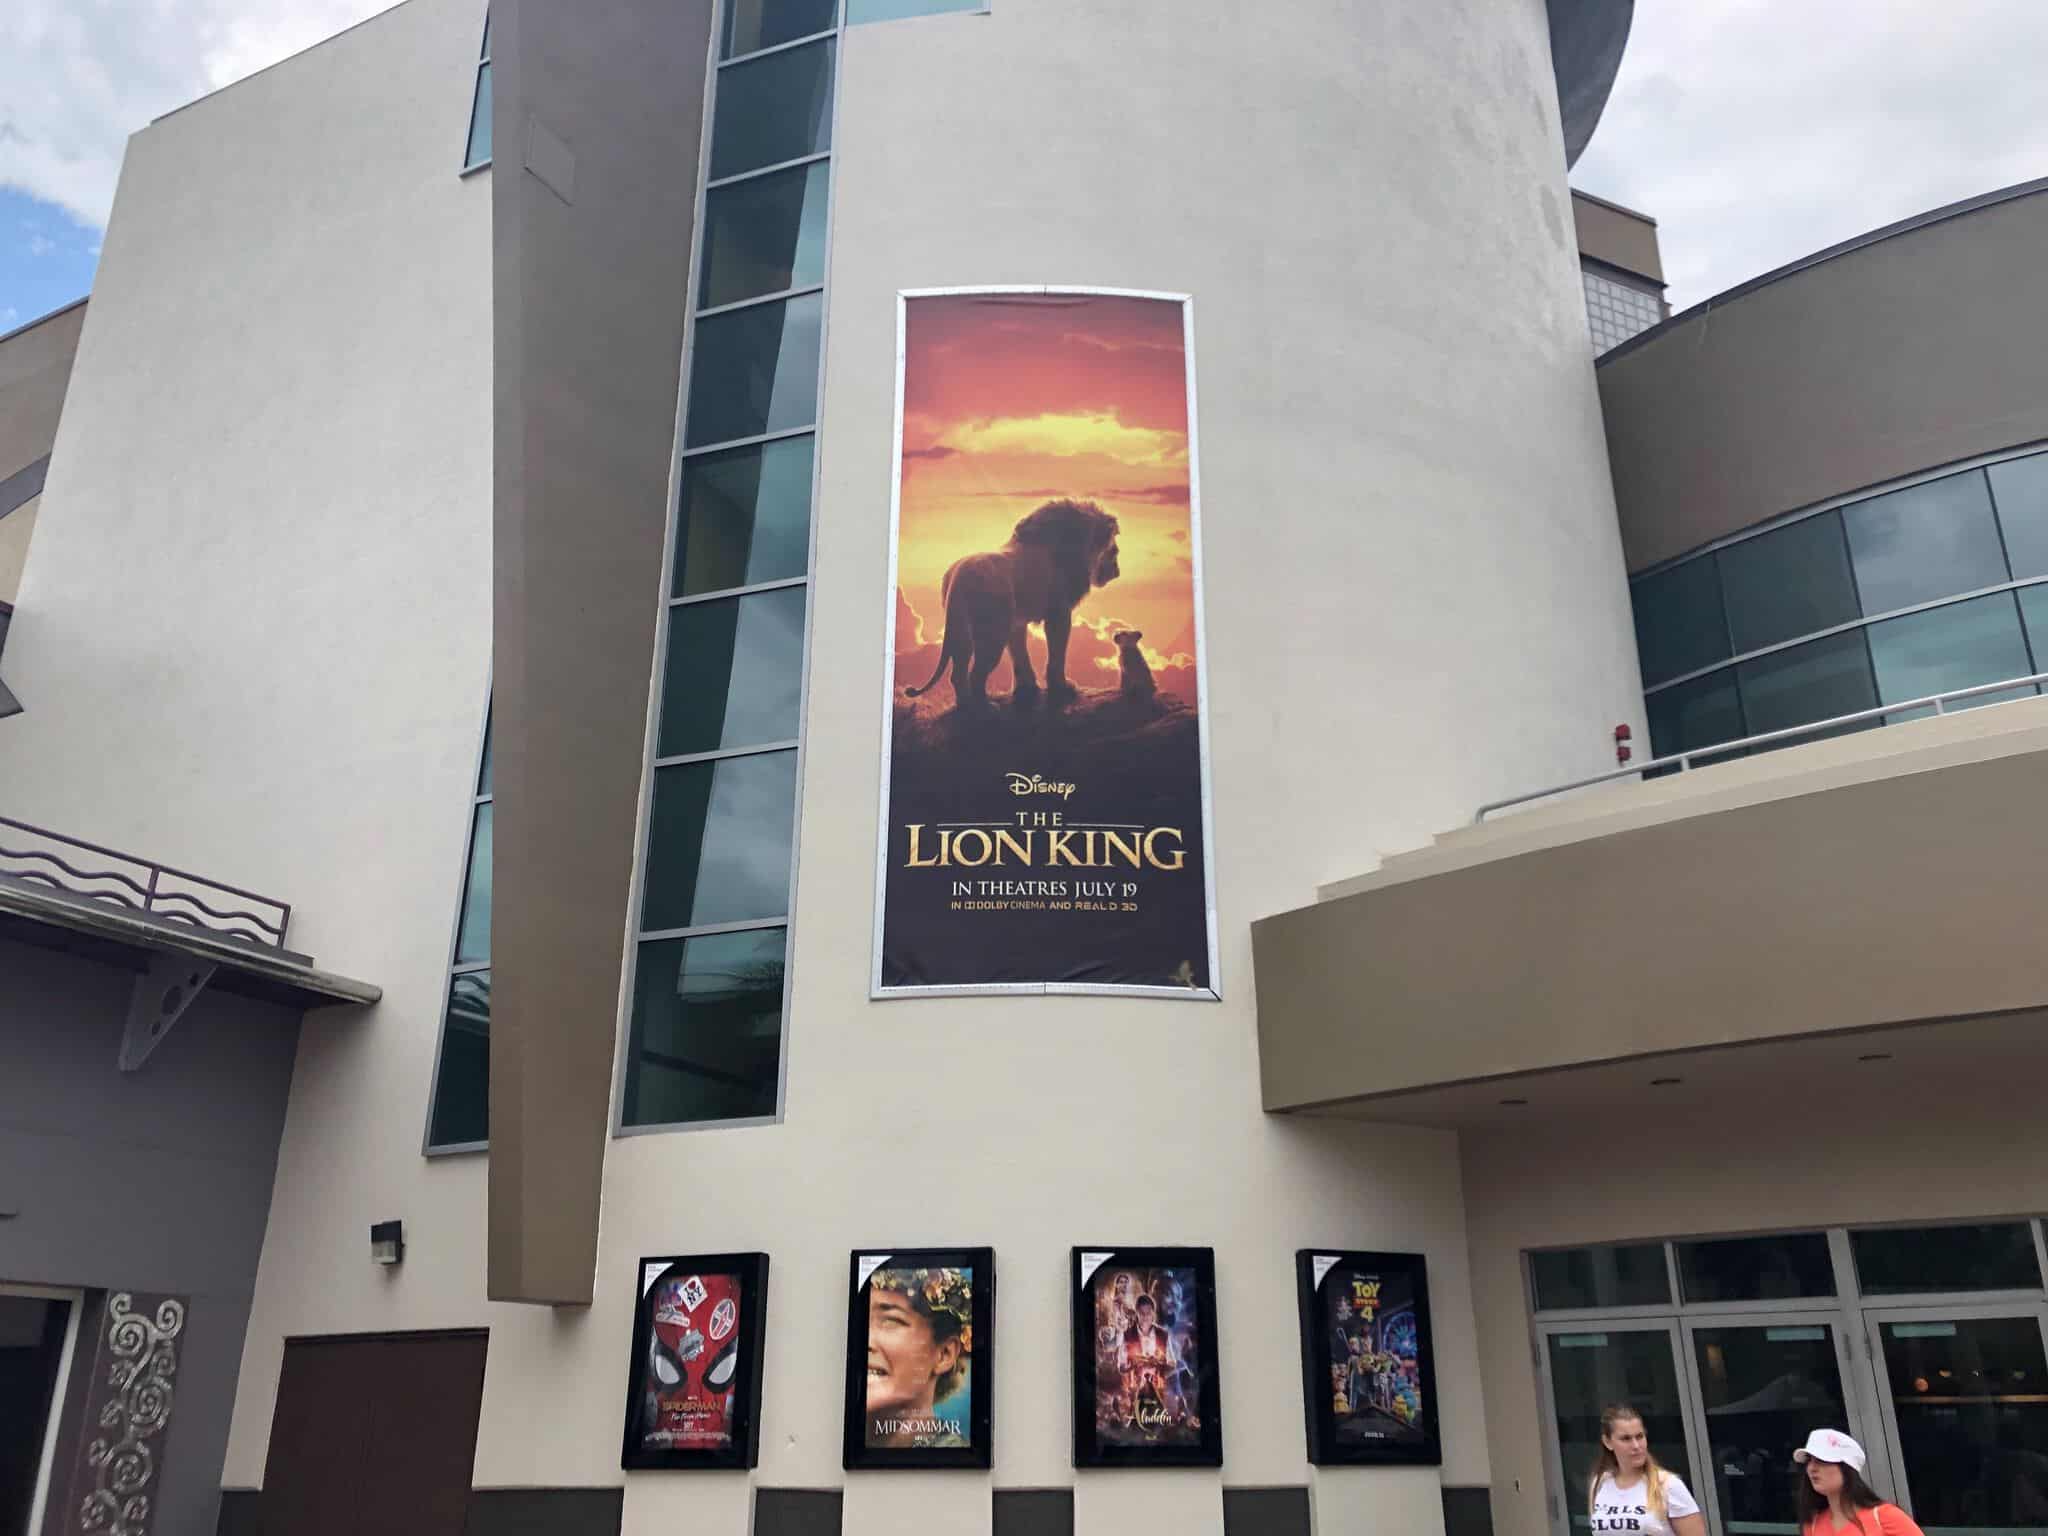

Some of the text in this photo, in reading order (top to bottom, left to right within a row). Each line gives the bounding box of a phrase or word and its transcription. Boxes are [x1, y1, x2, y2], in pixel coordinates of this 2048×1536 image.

[1005, 772, 1076, 800] Disney
[1015, 812, 1063, 826] THE
[903, 824, 1188, 870] LION KING
[952, 880, 1137, 898] IN THEATRES JULY 19
[951, 901, 961, 910] IN
[976, 901, 1009, 910] DOLBY
[1010, 901, 1046, 910] CINEMA
[1049, 901, 1071, 910] AND
[1121, 903, 1138, 911] 3D
[1360, 1306, 1374, 1322] 4
[875, 1419, 961, 1435] MIDSOMMAR
